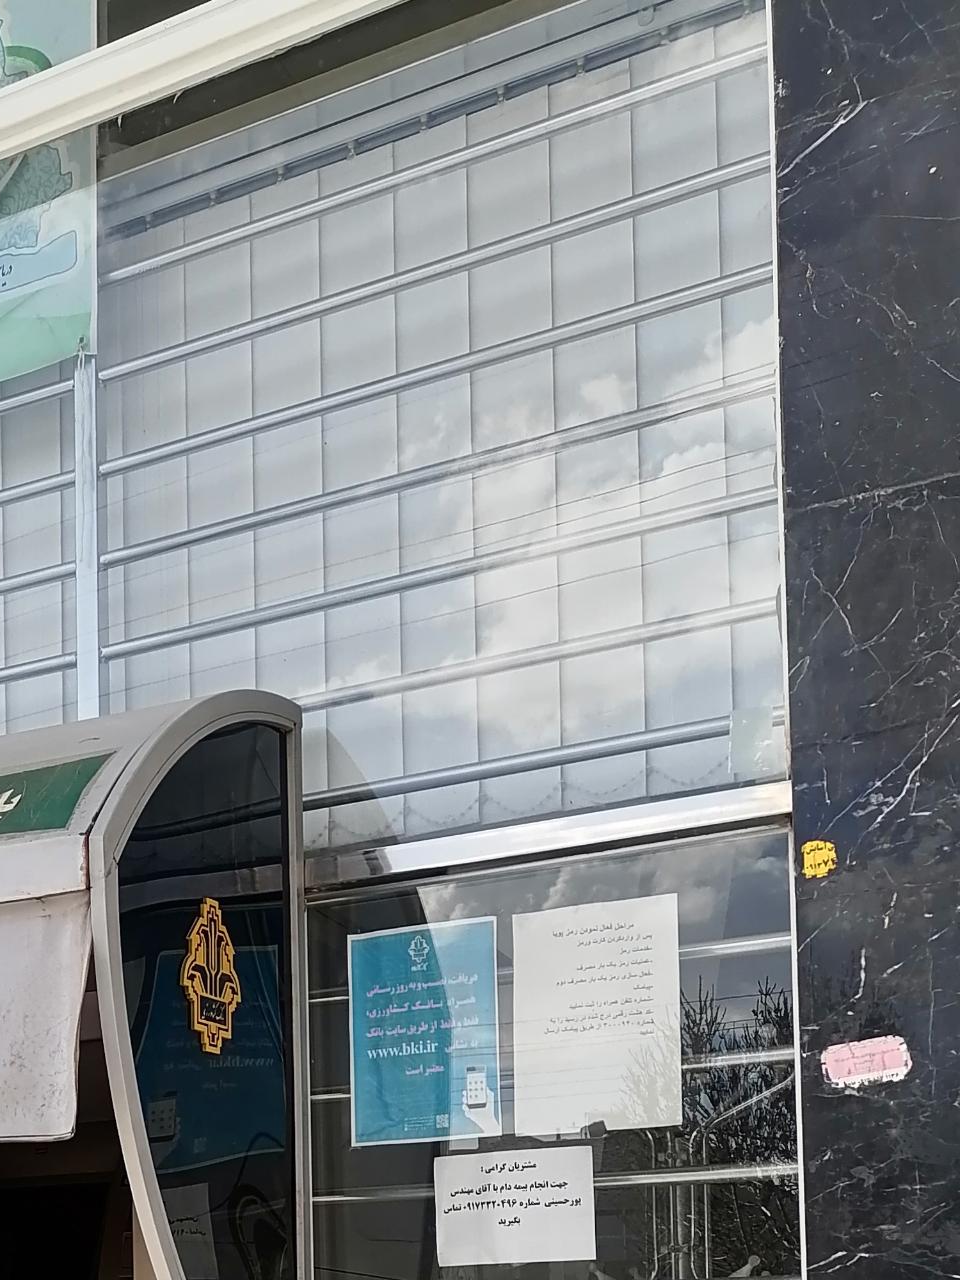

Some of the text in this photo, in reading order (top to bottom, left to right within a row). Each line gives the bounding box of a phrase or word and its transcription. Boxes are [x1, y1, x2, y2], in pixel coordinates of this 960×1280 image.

[565, 928, 578, 936] رمز
[366, 1027, 384, 1038] بانک
[367, 1040, 439, 1059] www.bki.ir
[508, 1161, 537, 1172] مشتریان
[450, 1181, 568, 1197] جهت انجام بیمه دام با آقای مهندس
[443, 1203, 462, 1214] تماس
[519, 1199, 541, 1208] شماره
[498, 1216, 521, 1226] بگیرید
